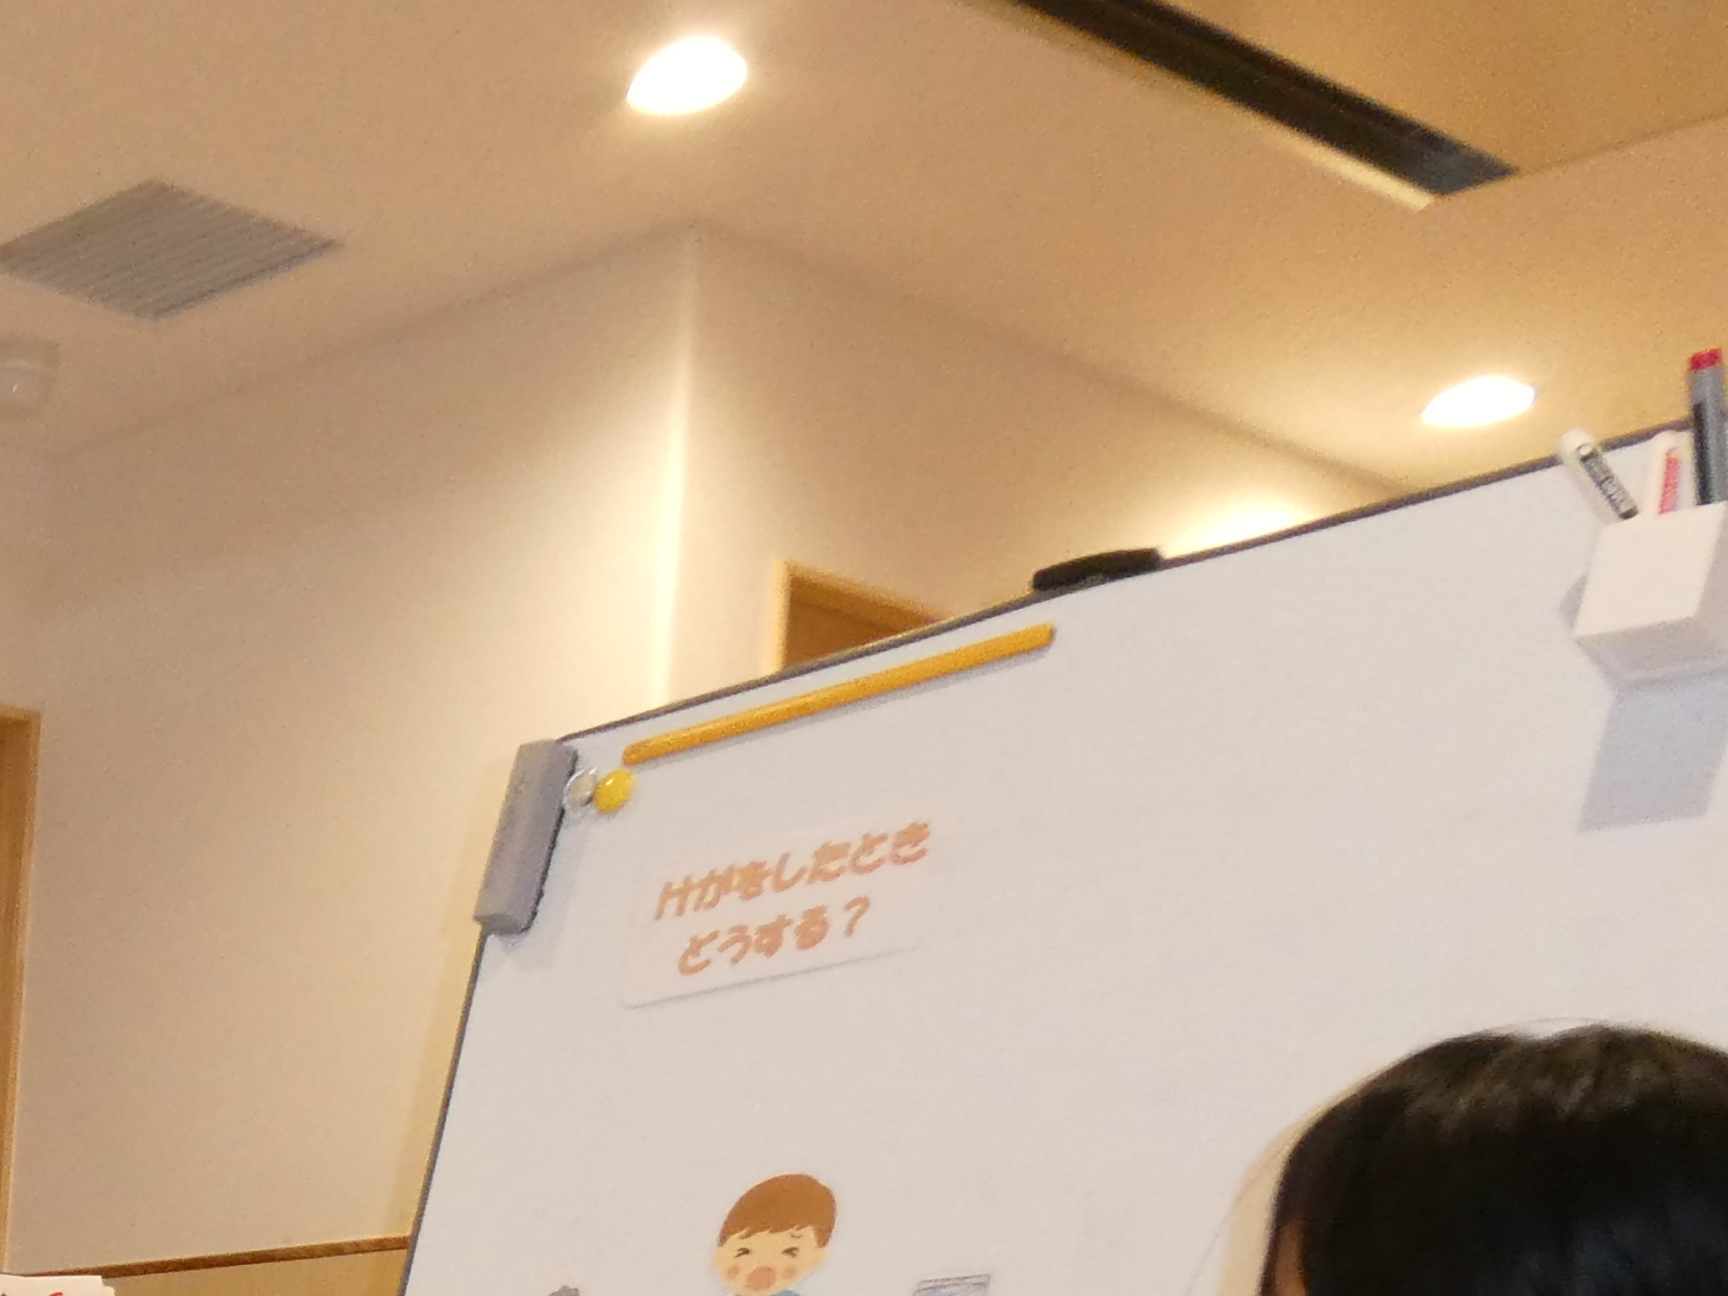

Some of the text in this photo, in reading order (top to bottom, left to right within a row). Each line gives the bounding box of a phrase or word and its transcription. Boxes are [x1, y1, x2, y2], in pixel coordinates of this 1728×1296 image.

[653, 820, 931, 920] けがをしたとき
[678, 895, 871, 976] どうする？
